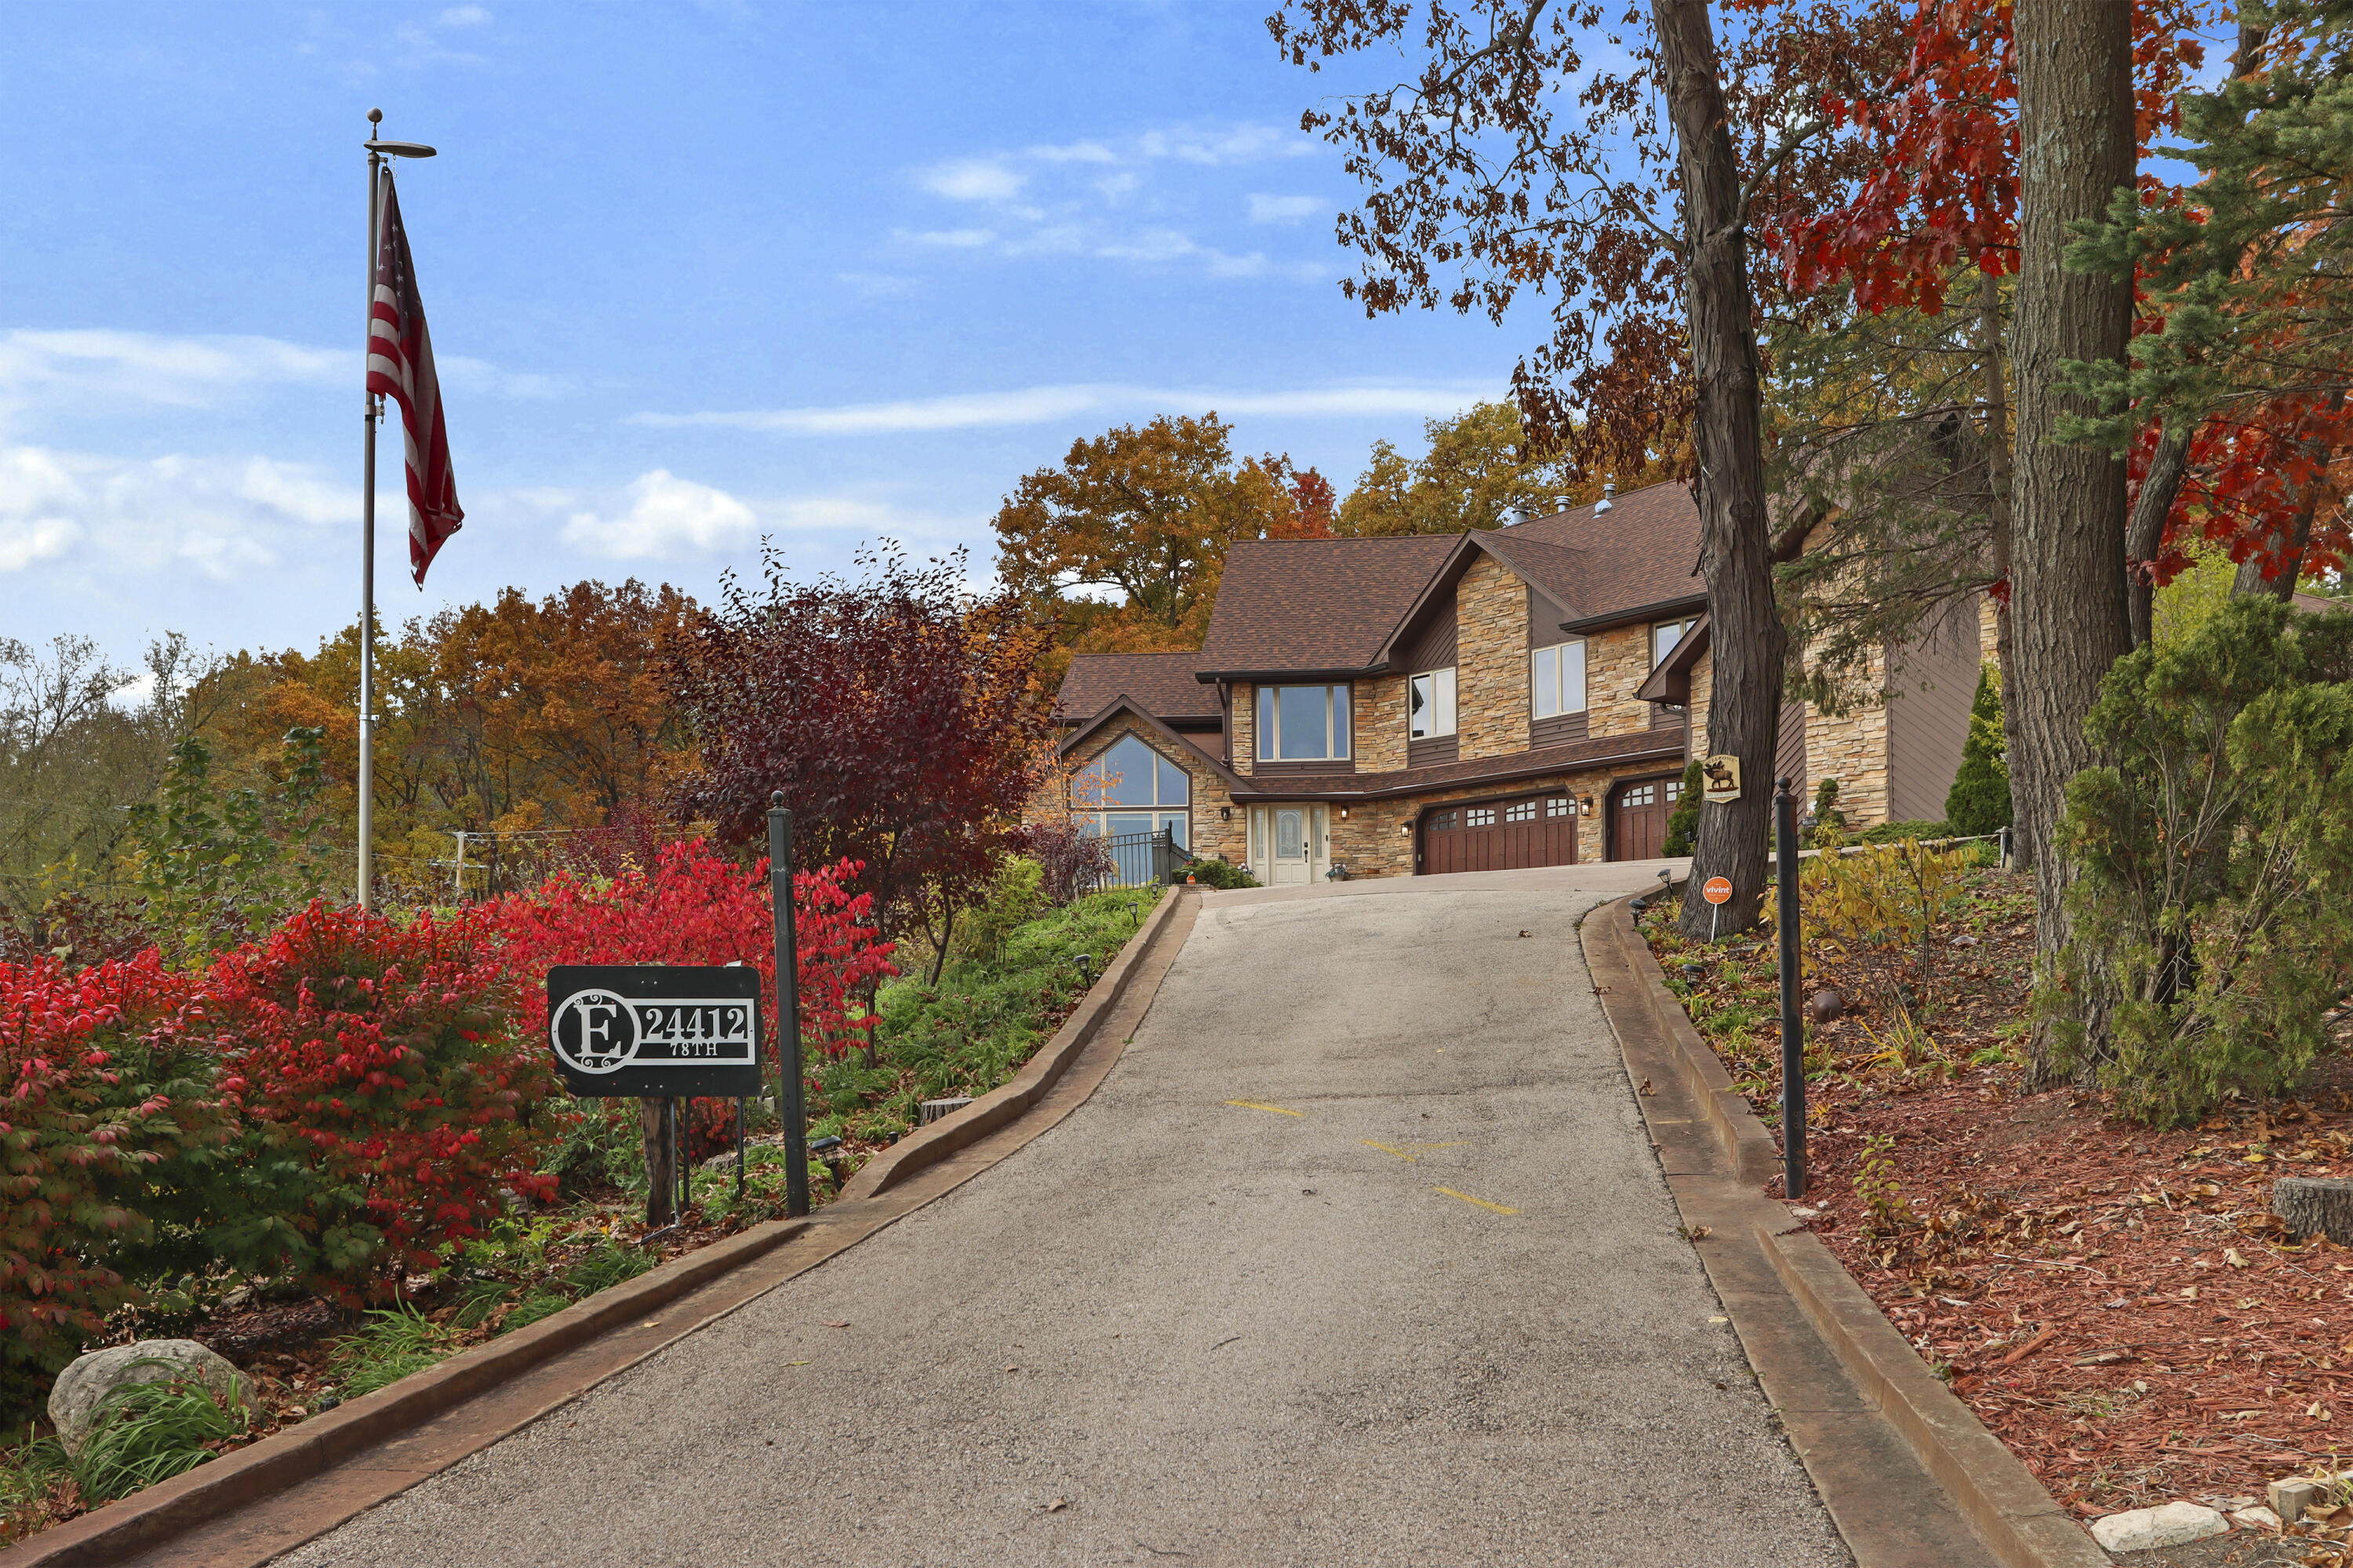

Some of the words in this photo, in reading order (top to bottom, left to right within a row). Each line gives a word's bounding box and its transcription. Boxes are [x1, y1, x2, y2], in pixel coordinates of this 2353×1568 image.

[573, 1003, 623, 1058] E
[646, 1007, 745, 1040] 24412
[670, 1042, 718, 1057] 78TH
